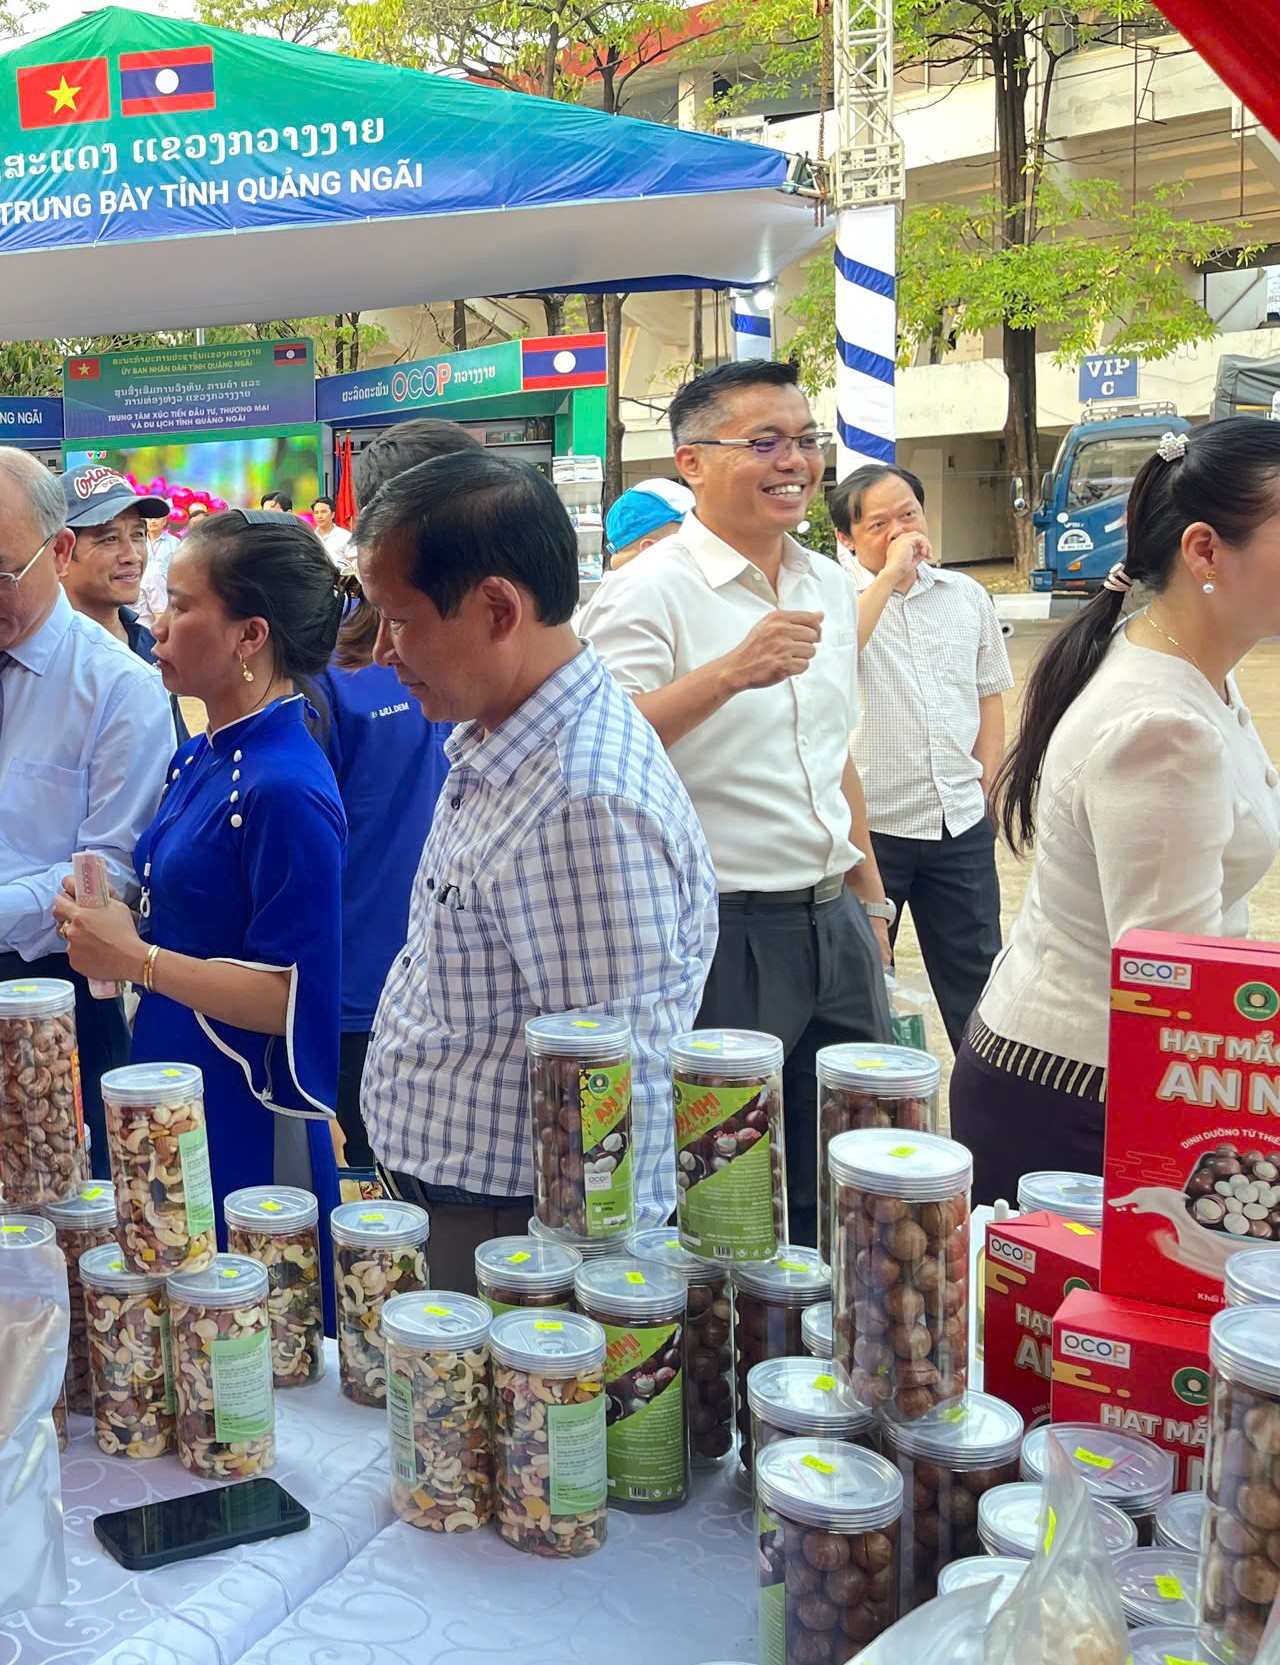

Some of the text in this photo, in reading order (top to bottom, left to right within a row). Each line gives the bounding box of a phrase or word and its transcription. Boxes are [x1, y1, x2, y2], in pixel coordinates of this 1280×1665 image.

[100, 182, 153, 215] BÀY
[160, 176, 229, 208] TỈNH
[237, 167, 341, 204] QUẢNG
[350, 159, 423, 193] NGÃI
[132, 366, 148, 375] BAN
[149, 365, 171, 374] NHÂN
[171, 364, 187, 373] DÂN
[207, 360, 233, 370] QUẢNG
[234, 359, 253, 368] NGÃI
[1086, 357, 1131, 378] VIP
[392, 362, 451, 402] OCOP
[1101, 381, 1115, 397] C
[17, 409, 42, 424] NGÃI
[108, 413, 132, 422] TRUNG
[134, 412, 151, 420] TÂM
[152, 410, 169, 419] XÚC
[171, 408, 187, 418] TIẾN
[188, 406, 204, 417] ĐẦU
[220, 405, 253, 414] THƯƠNG
[254, 404, 270, 413] MẠI
[131, 414, 246, 429] VÀ DU LỊCH TỈNH QUẢNG NGÃI
[1123, 961, 1188, 981] OCOP
[1160, 1027, 1224, 1061] HẠT
[1156, 1061, 1242, 1111] AN
[593, 1096, 619, 1124] AN
[688, 1092, 721, 1120] NHI
[1180, 1135, 1204, 1149] DINH
[1204, 1127, 1240, 1140] DƯỠNG
[1242, 1128, 1257, 1138] TỪ
[991, 1238, 1034, 1264] OCOP
[1016, 1303, 1052, 1338] HẠT
[606, 1333, 641, 1362] NHI
[1064, 1335, 1127, 1359] OCOP
[1163, 1412, 1209, 1446] MẮ
